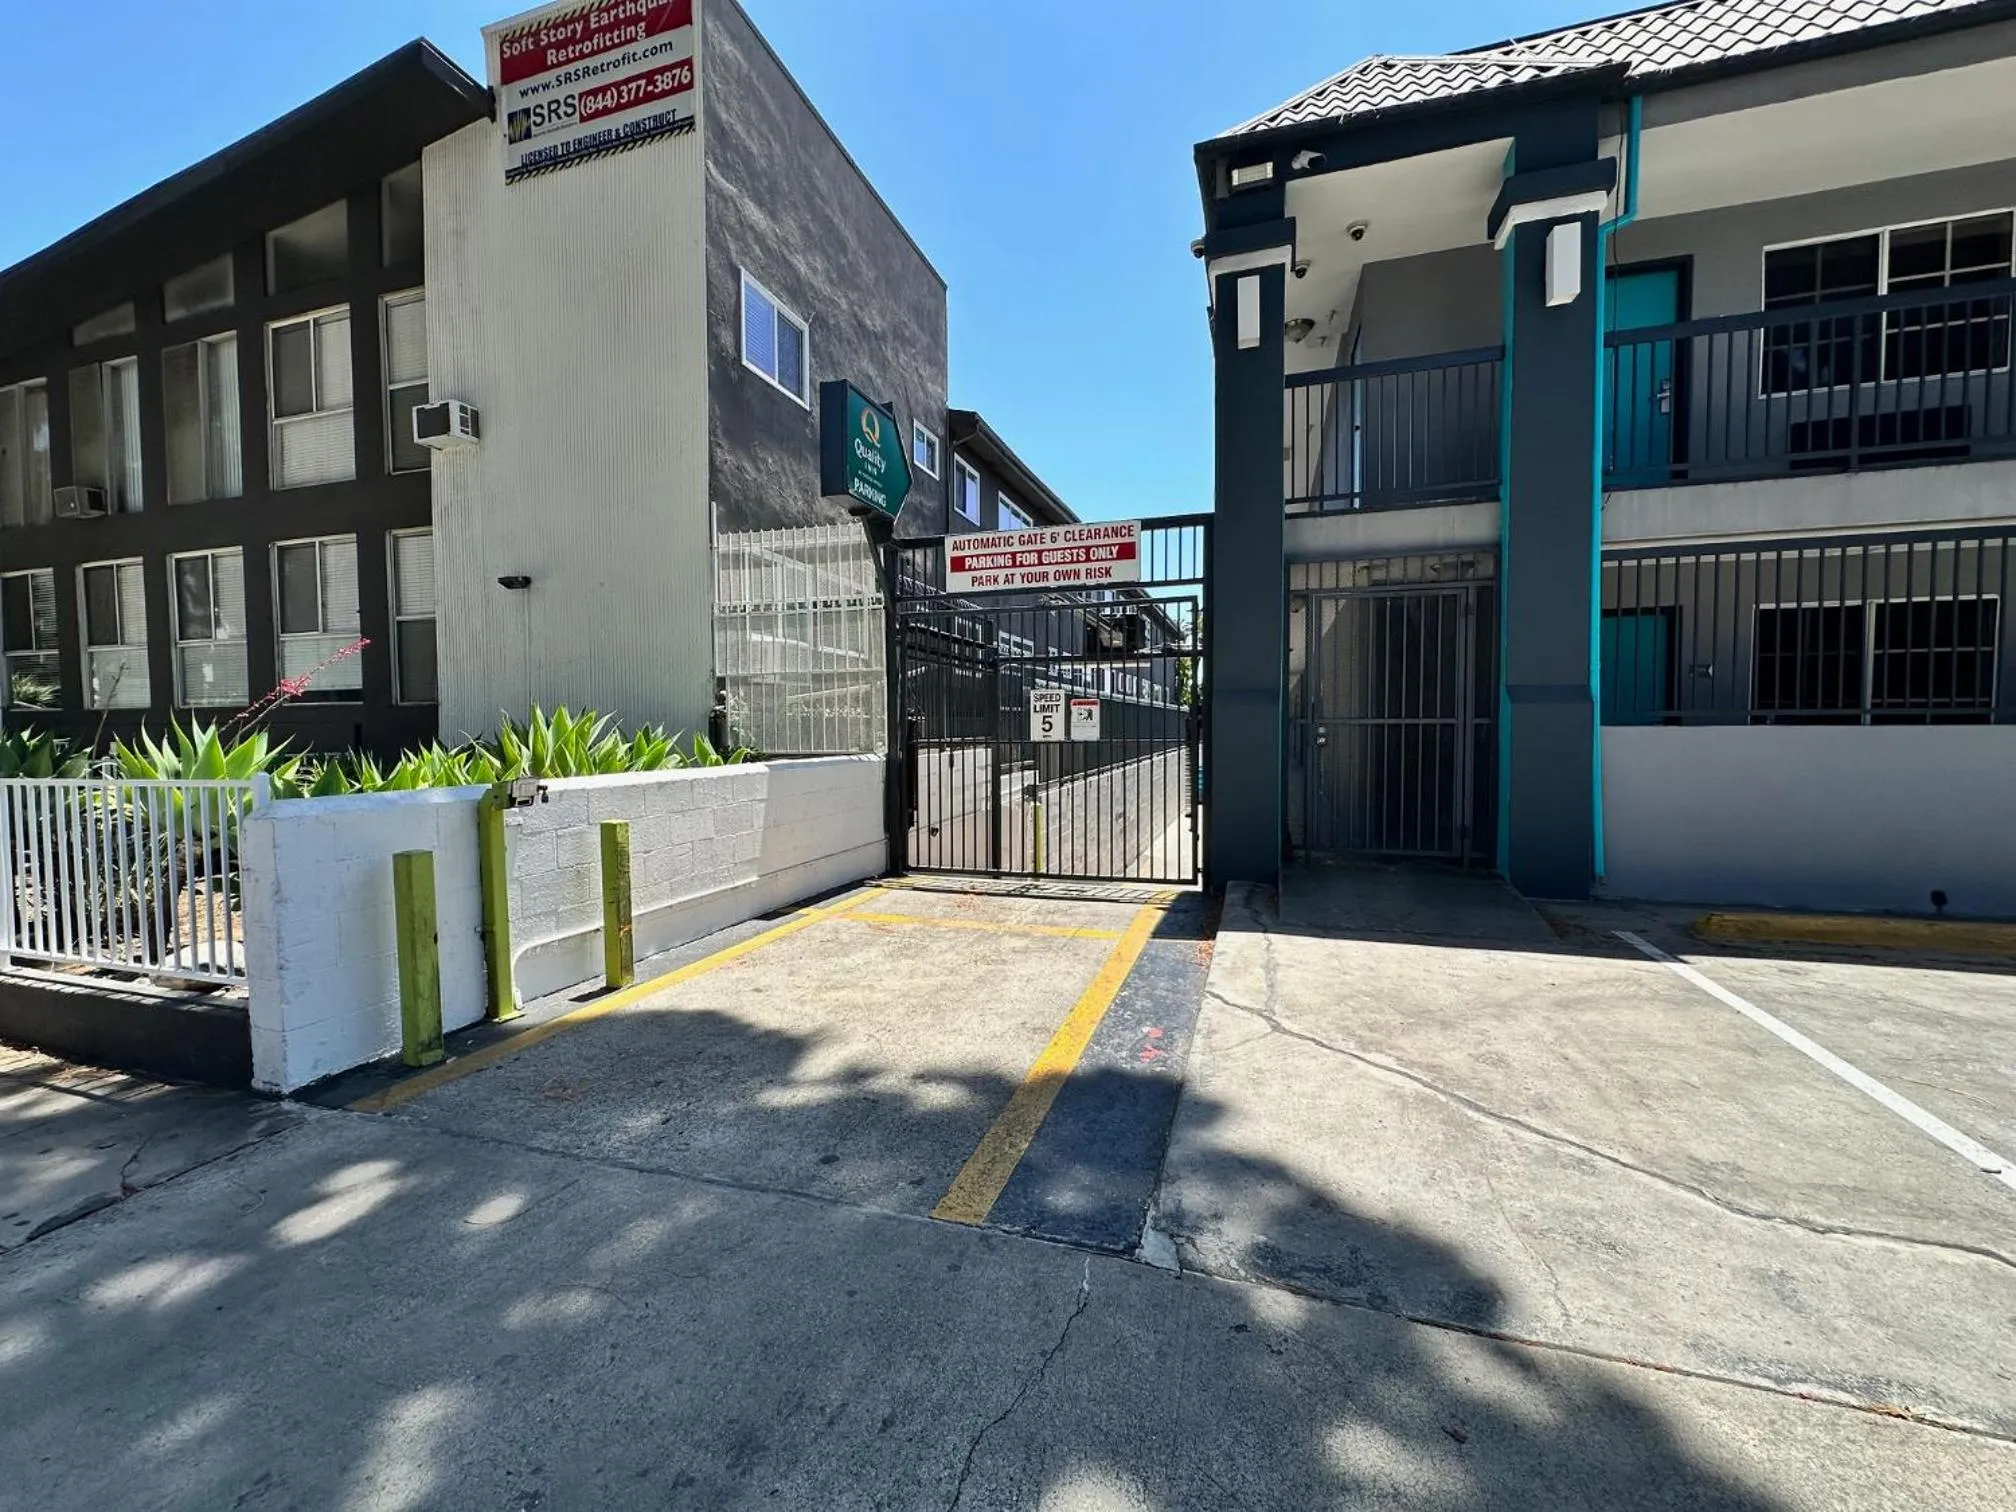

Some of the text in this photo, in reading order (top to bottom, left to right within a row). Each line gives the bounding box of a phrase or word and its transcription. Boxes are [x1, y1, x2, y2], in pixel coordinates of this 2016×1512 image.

[502, 0, 673, 59] Soft Story Earthqu
[547, 21, 646, 65] Retrofitting
[519, 41, 673, 98] www.SRSRetrofit.com
[532, 66, 691, 127] SRS (844) 377-3876
[520, 144, 558, 167] LICENSED
[560, 140, 571, 155] TO
[573, 128, 613, 152] ENGINEER
[614, 126, 622, 138] &
[622, 109, 677, 138] CONSTRUCT
[854, 438, 887, 474] Quality
[854, 477, 887, 508] PARKING
[952, 536, 1014, 552] AUTOMATIC
[1018, 532, 1046, 547] GATE
[1064, 525, 1135, 543] CLEARANCE
[965, 545, 1119, 570] PARKING FOR GUESTS ONLY
[971, 566, 1112, 587] PARK AT YOUR OWN RISK
[1033, 693, 1061, 702] SPEED
[1033, 704, 1061, 713] LIMIT
[1041, 715, 1053, 732] 5
